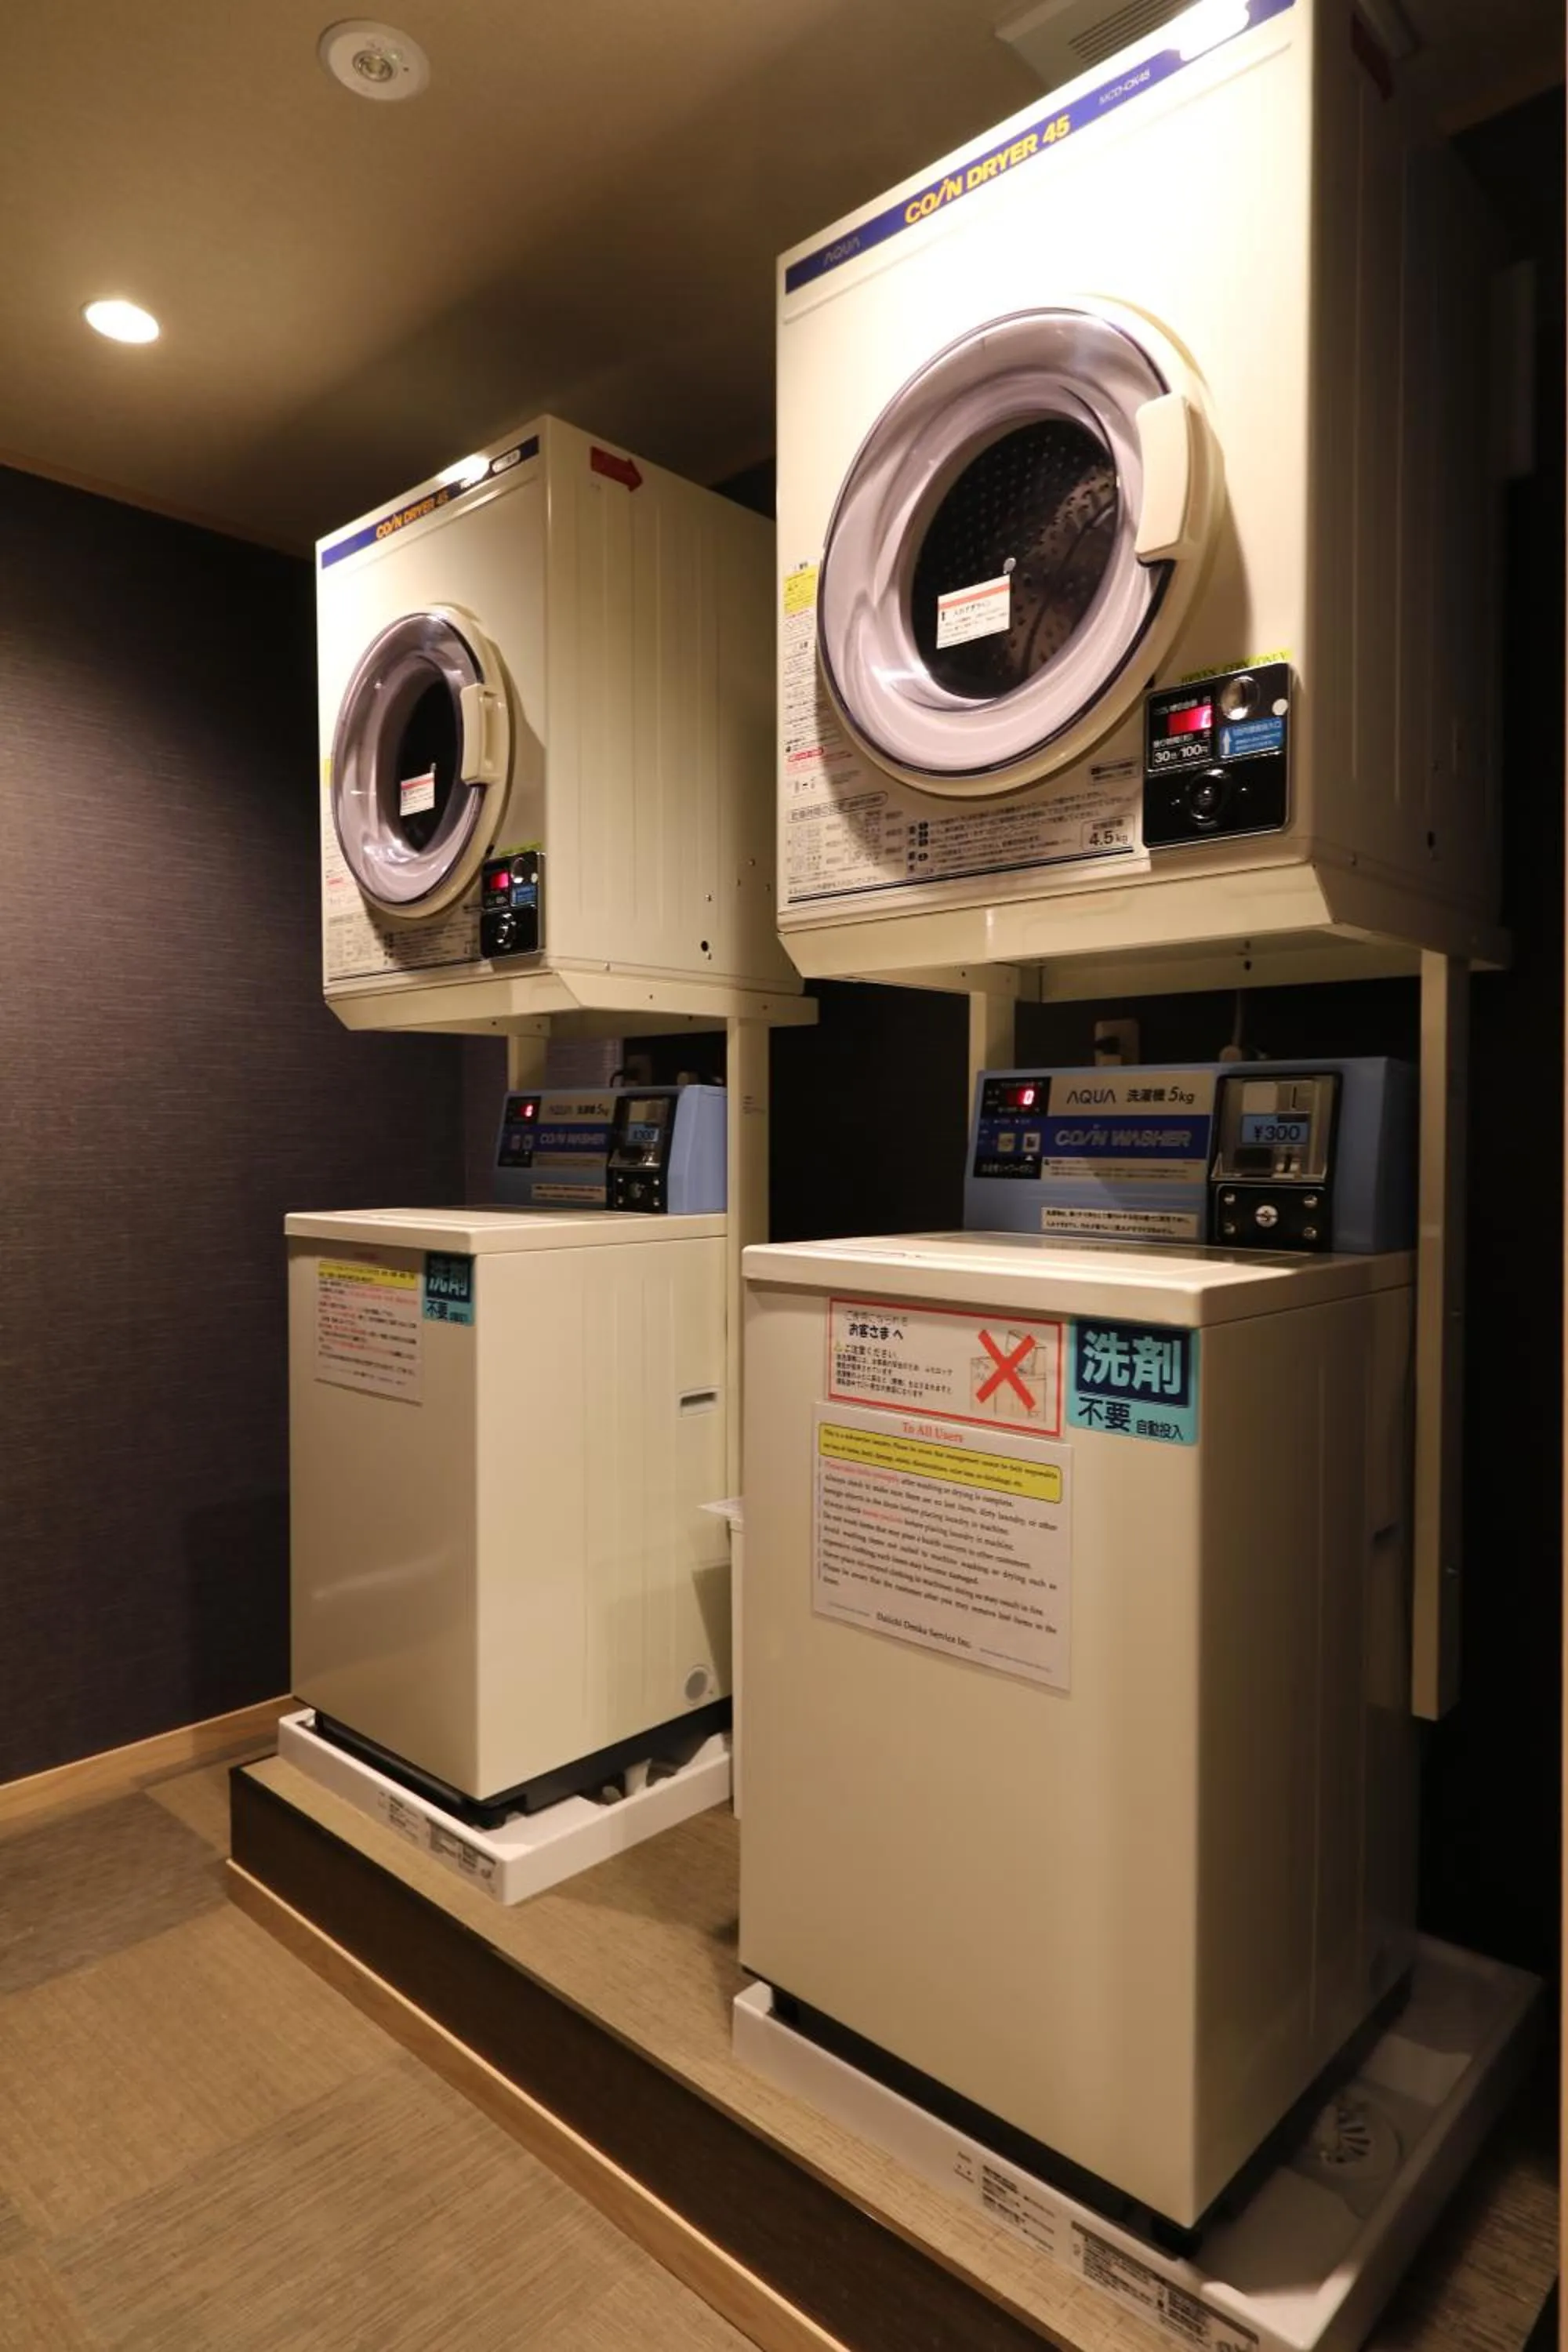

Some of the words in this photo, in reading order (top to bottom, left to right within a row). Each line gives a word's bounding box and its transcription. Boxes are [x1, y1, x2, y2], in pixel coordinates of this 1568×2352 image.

[824, 238, 860, 267] AQUA
[967, 134, 1038, 190] DRYER
[1042, 114, 1071, 144] 45
[1066, 1088, 1116, 1105] AQUA
[1127, 1088, 1165, 1103] 洗濯機
[1110, 1129, 1192, 1148] WASHER
[1255, 1124, 1301, 1142] ¥300
[849, 1323, 903, 1340] お客さまへ
[1082, 1330, 1182, 1396] 洗剤
[1078, 1396, 1131, 1432] 不要
[1137, 1419, 1184, 1441] 自動投入
[902, 1421, 913, 1434] To
[917, 1423, 931, 1437] All
[935, 1426, 962, 1443] Users
